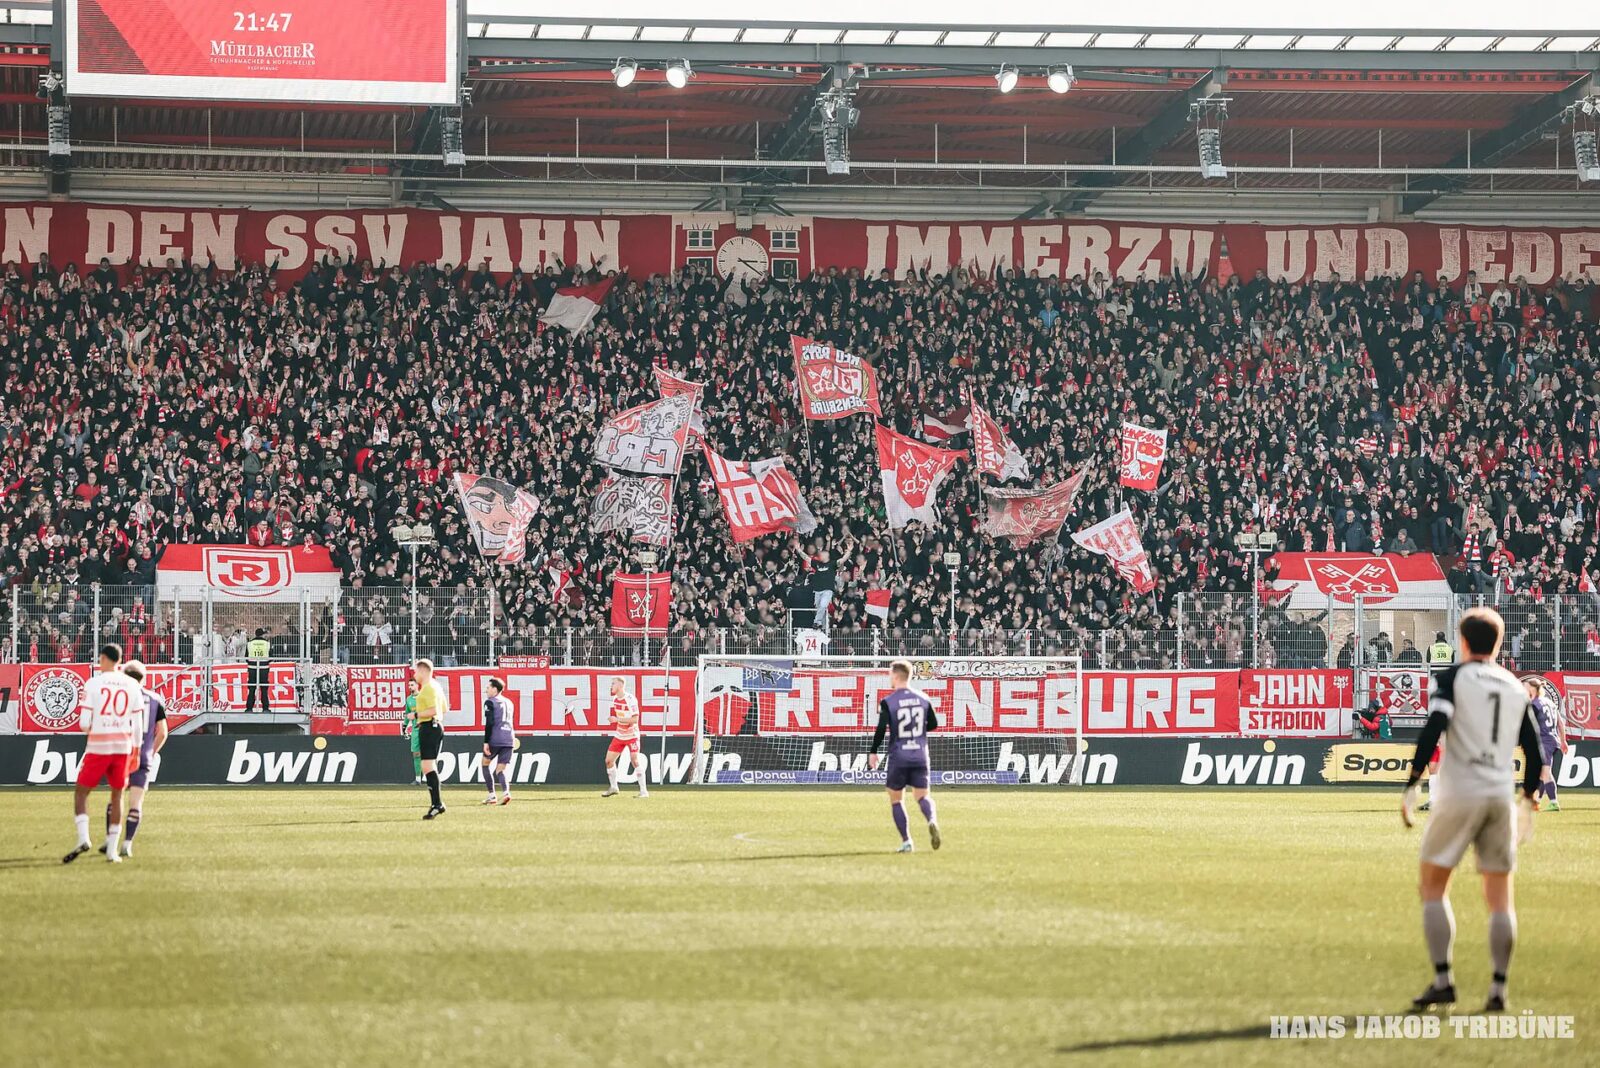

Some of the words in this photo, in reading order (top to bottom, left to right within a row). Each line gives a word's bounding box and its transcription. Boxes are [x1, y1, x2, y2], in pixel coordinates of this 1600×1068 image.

[233, 11, 292, 32] 21:47
[210, 40, 315, 58] MÜHLBACHER
[85, 208, 239, 271] DEN
[264, 213, 408, 270] SSV
[436, 216, 621, 275] JAHN
[864, 225, 1214, 282] IMMERZU
[1265, 228, 1409, 284] UND
[805, 639, 816, 651] 24
[351, 668, 372, 680] SSV
[376, 668, 405, 680] JAHN
[352, 682, 406, 709] 1889
[1250, 674, 1325, 706] JAHN
[100, 687, 129, 717] 20
[165, 699, 230, 712] Regensurg
[897, 706, 924, 738] 23
[1248, 711, 1326, 730] STADION
[1488, 692, 1501, 743] 1
[226, 737, 357, 782] bwin
[1181, 740, 1305, 784] bwin
[755, 771, 796, 780] Donau
[856, 771, 888, 780] Dona
[955, 771, 997, 780] Donau
